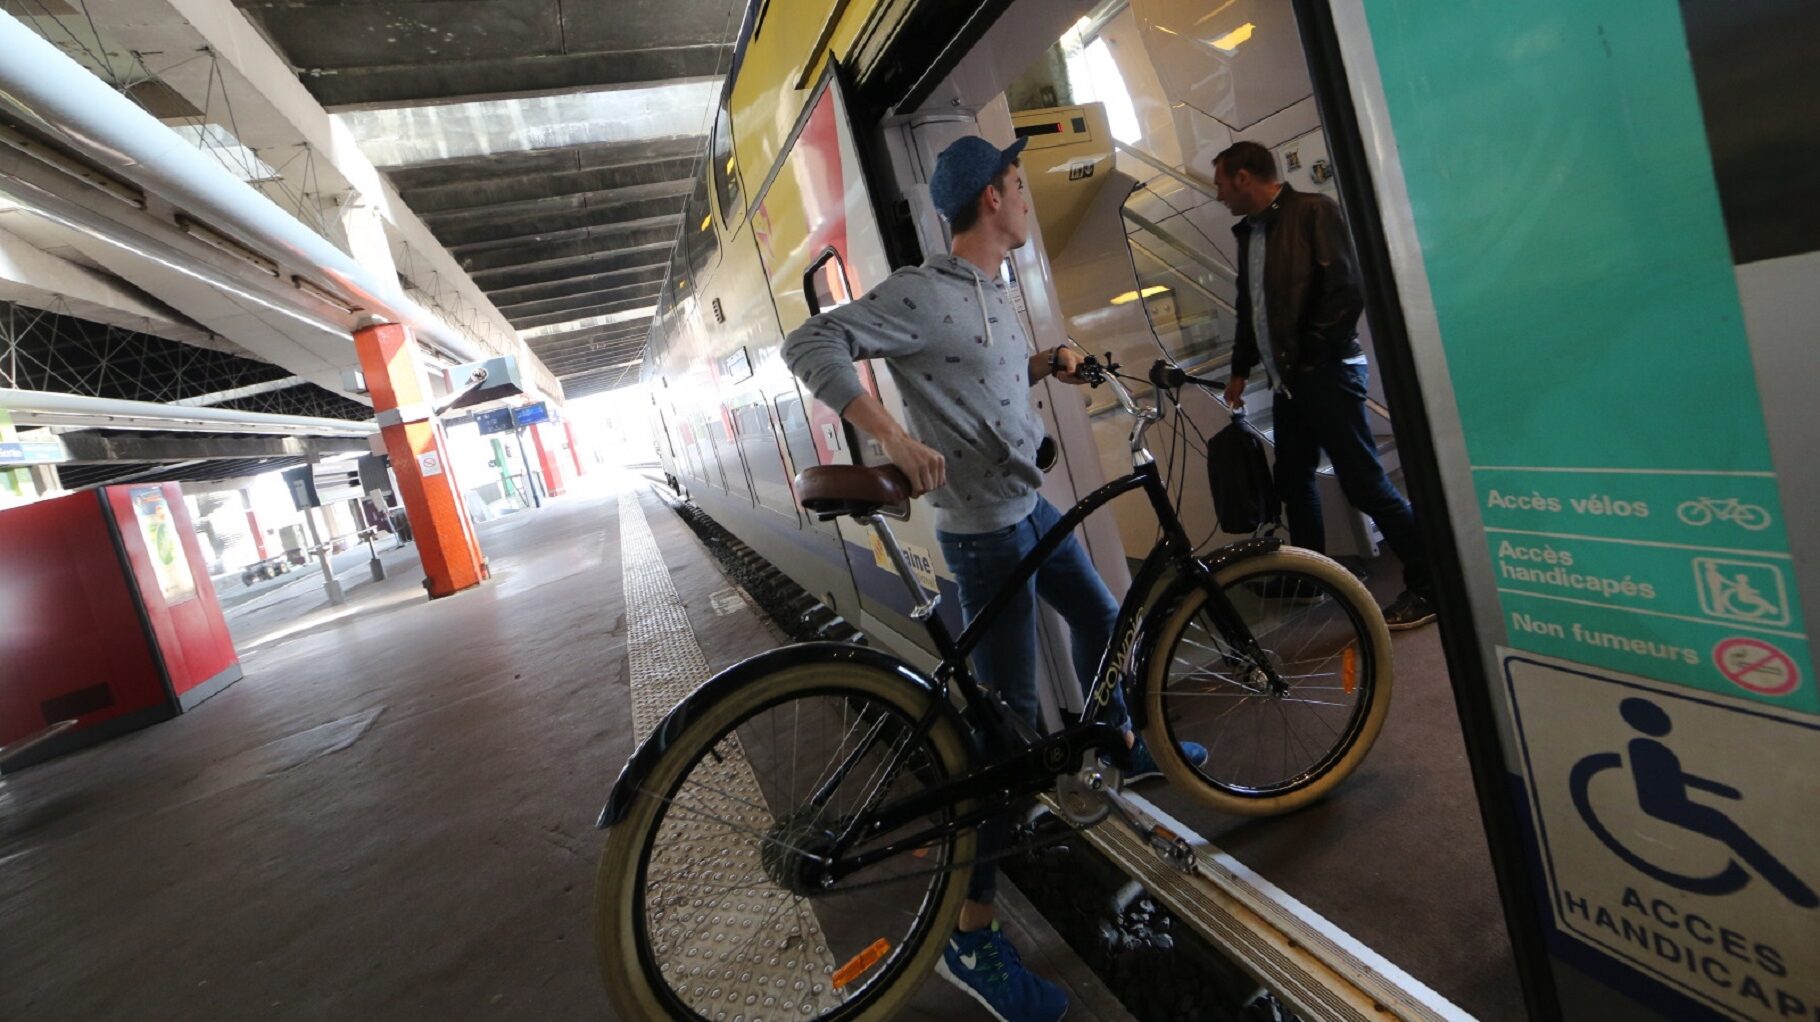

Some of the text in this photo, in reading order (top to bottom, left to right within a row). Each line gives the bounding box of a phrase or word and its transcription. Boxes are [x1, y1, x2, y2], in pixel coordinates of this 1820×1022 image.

[1487, 489, 1649, 518] Accès vélos
[902, 547, 931, 574] aine
[1499, 541, 1573, 565] Accès
[1500, 562, 1656, 597] handicapés
[1512, 612, 1700, 665] Non fumeurs
[1622, 887, 1787, 977] ACCES
